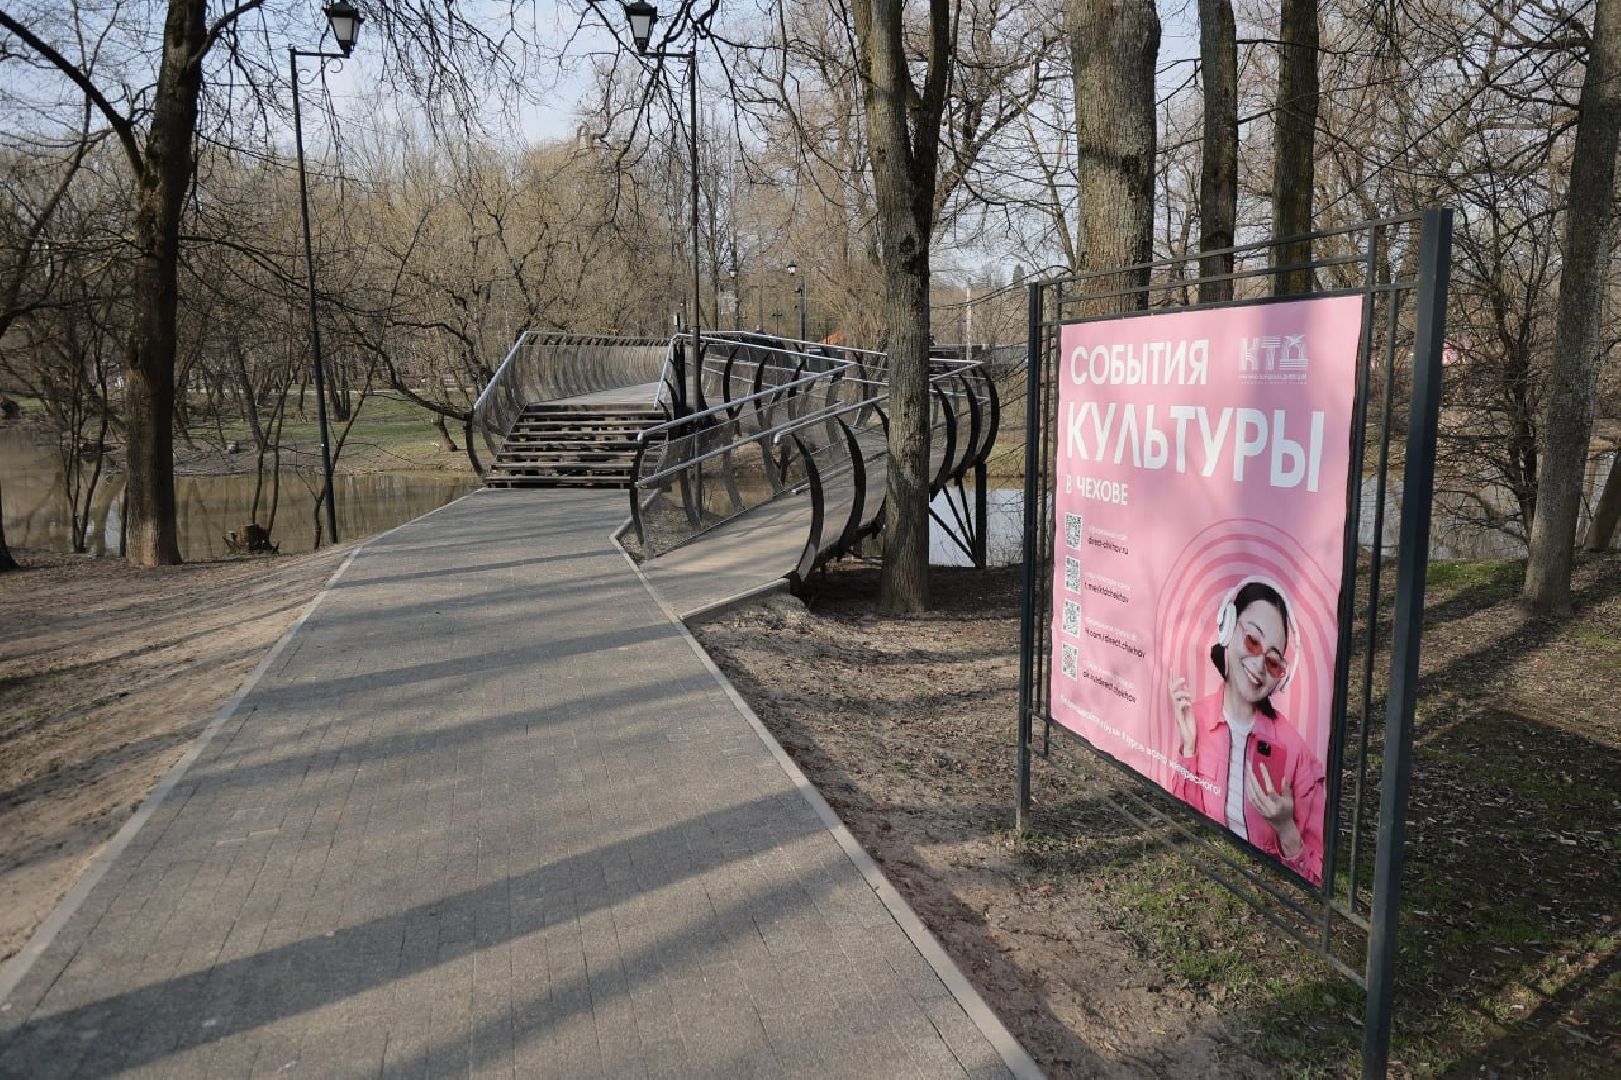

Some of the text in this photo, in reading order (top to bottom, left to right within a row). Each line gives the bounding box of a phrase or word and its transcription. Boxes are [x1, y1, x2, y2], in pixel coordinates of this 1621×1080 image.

[1071, 339, 1209, 385] СОБЫТИЯ
[1066, 401, 1325, 493] КУЛЬТУРЫ
[1065, 476, 1129, 506] В ЧЕХОВЕ
